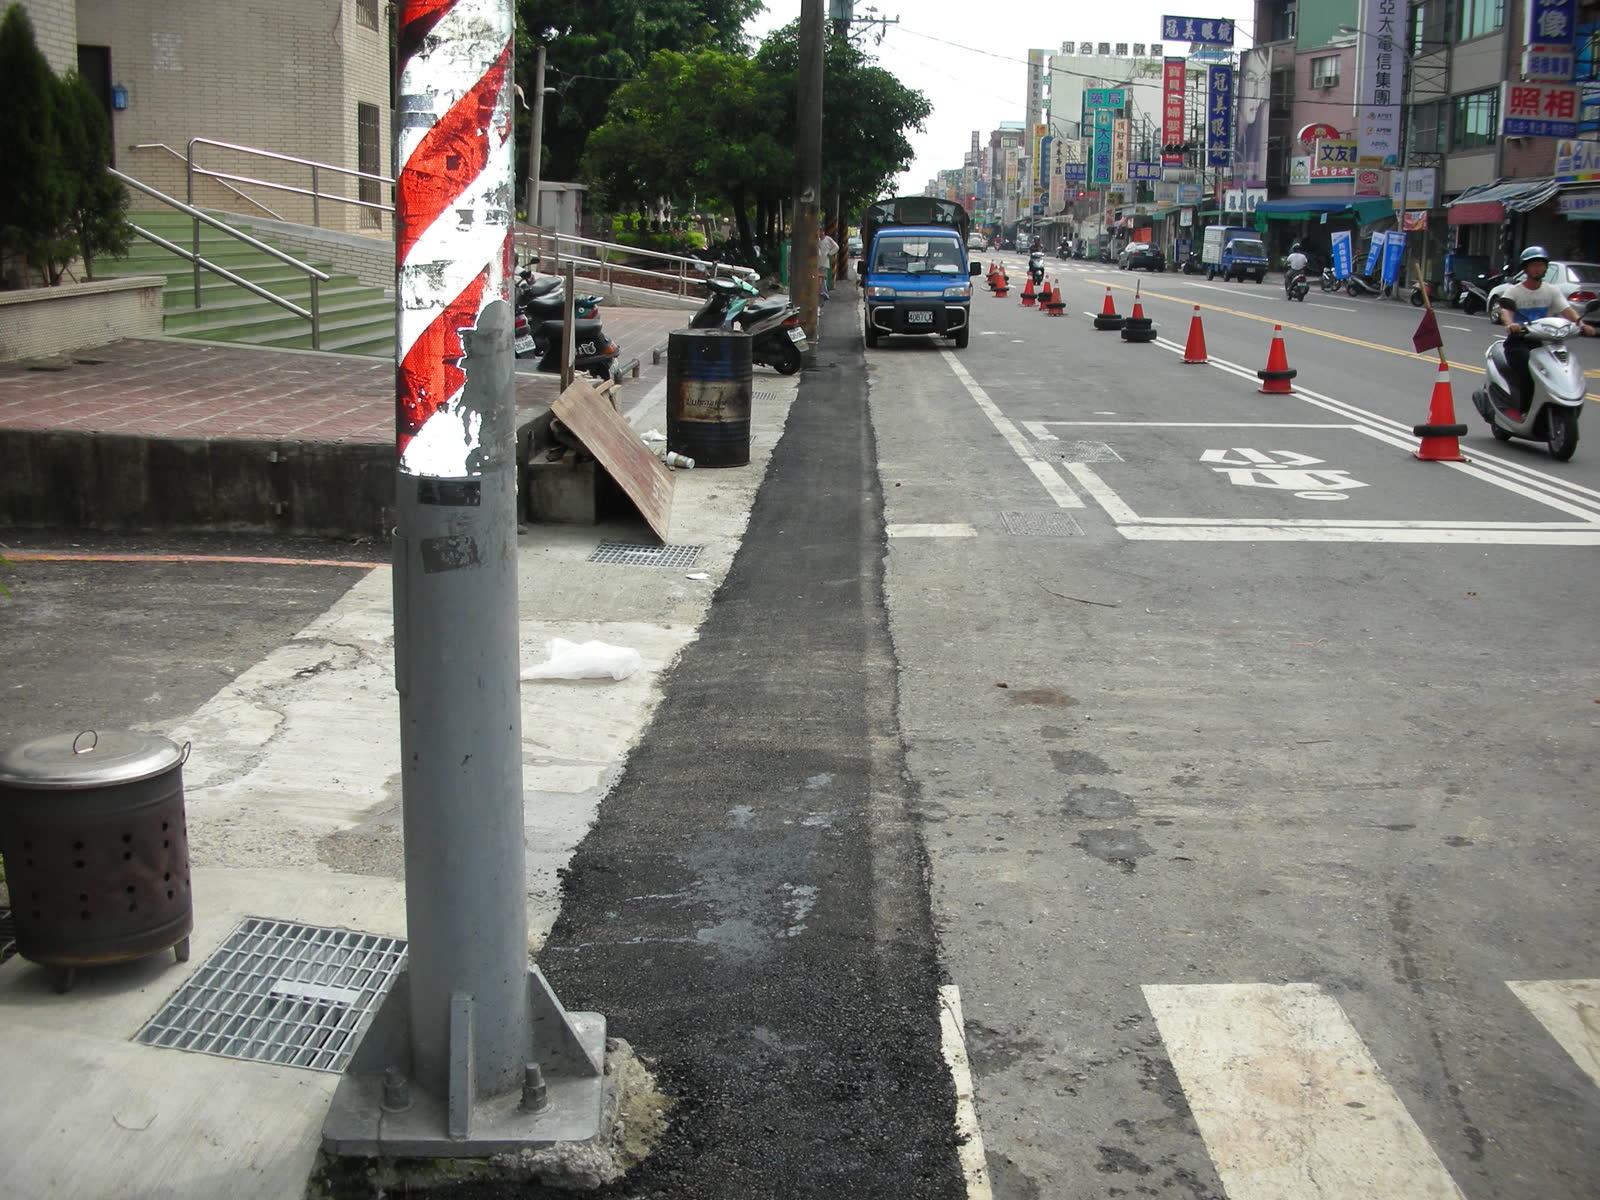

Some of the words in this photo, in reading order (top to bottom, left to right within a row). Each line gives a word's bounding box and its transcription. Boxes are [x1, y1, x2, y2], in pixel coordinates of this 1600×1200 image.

[1165, 19, 1232, 42] 冠美眼鏡
[1537, 0, 1569, 38] 像
[1375, 0, 1395, 106] 亞太電信集團
[1089, 92, 1121, 105] 藥局
[1212, 72, 1229, 160] 冠美眼鏡
[1510, 87, 1576, 119] 照相
[1096, 128, 1110, 179] 大力藥局
